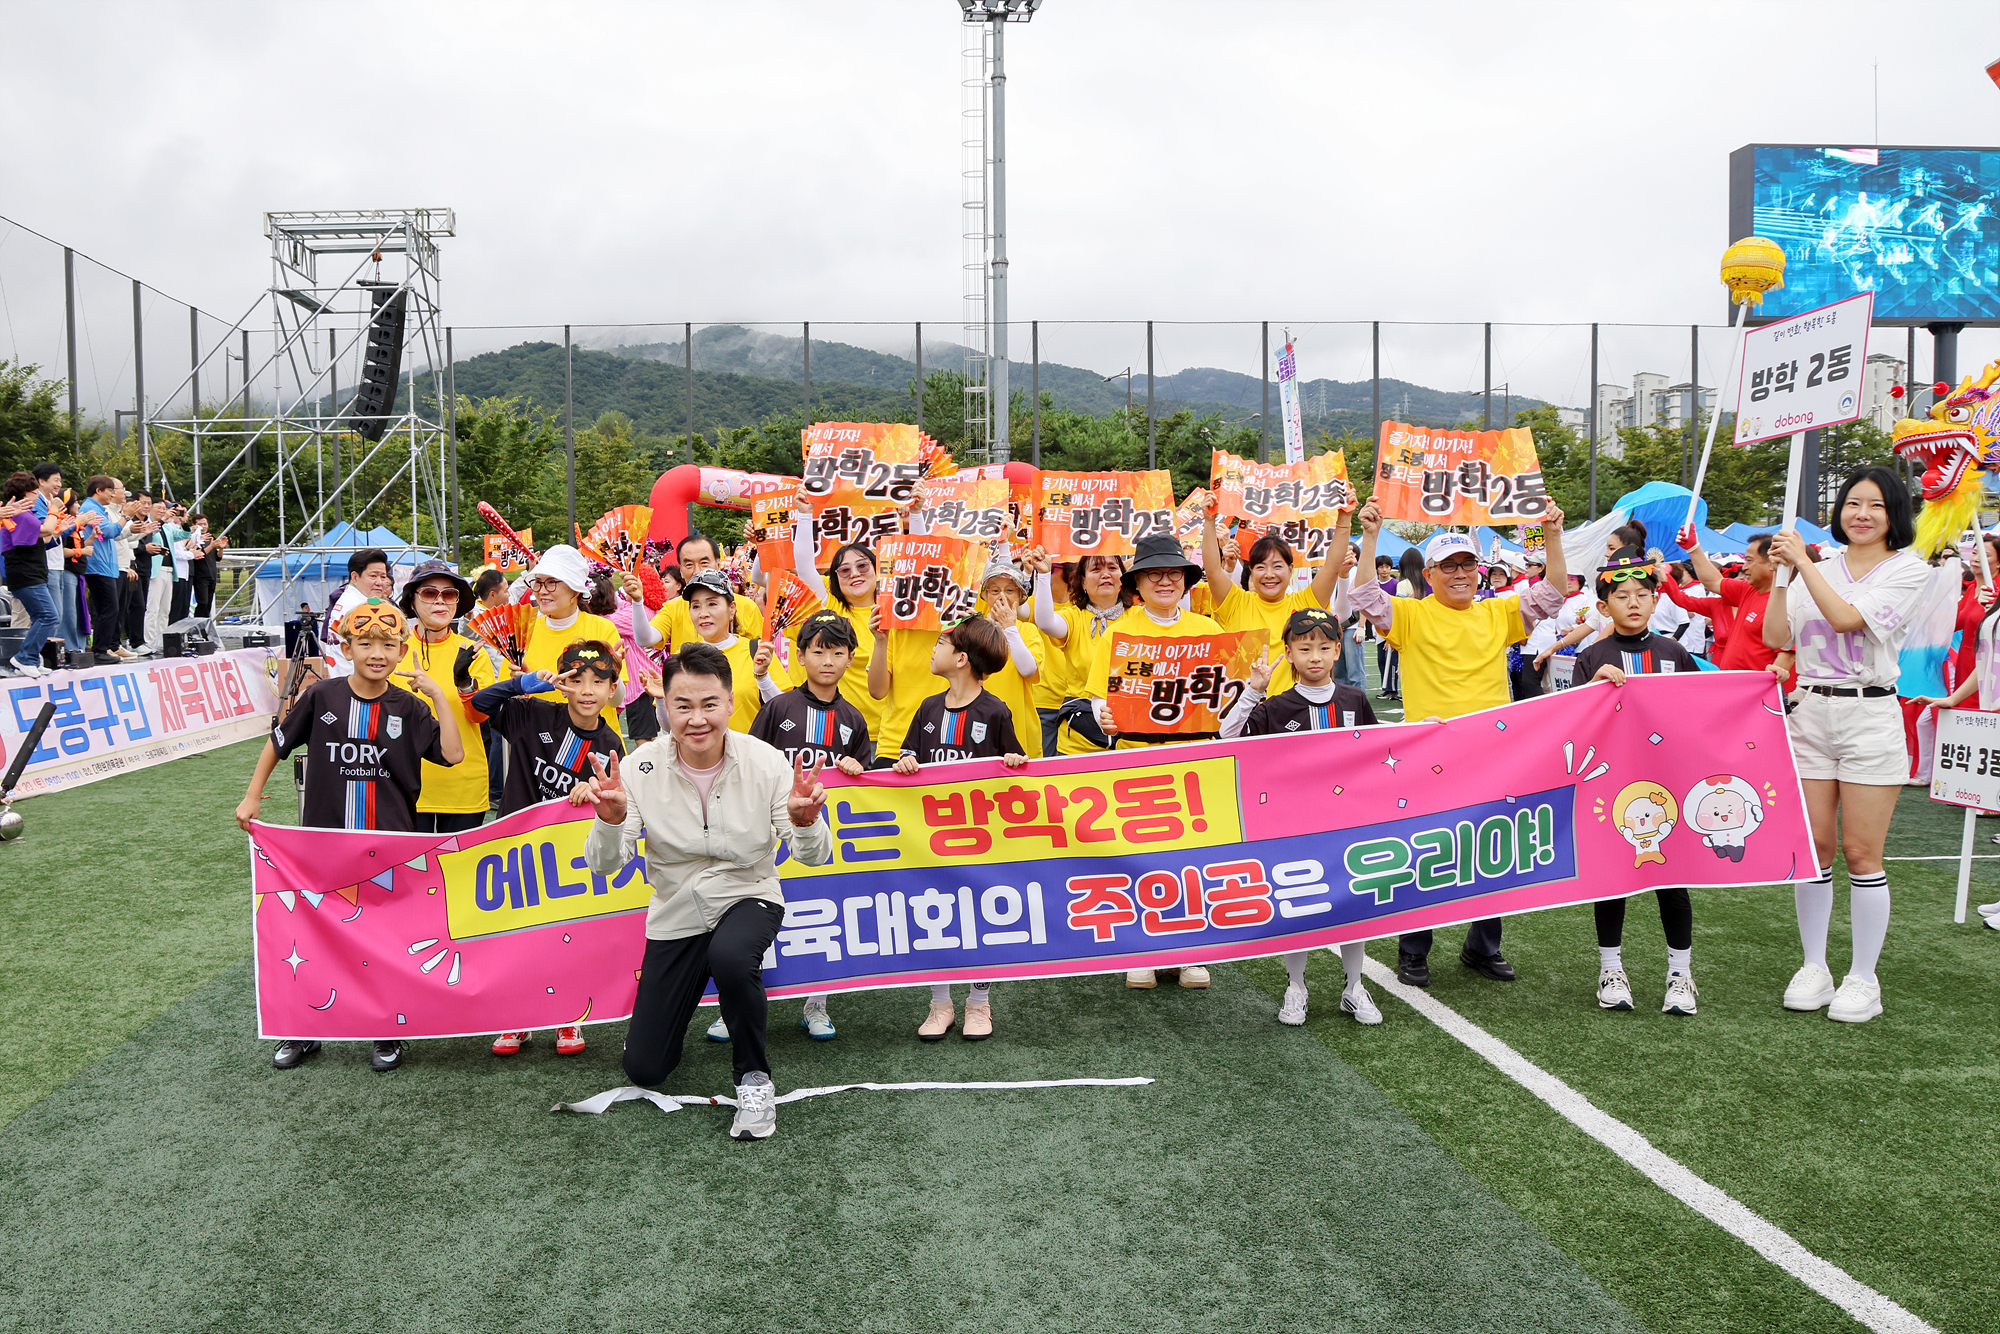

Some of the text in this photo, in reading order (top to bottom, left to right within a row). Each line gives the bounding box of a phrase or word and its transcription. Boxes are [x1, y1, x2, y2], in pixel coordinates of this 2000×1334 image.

[1803, 316, 1824, 332] 행복한
[1826, 311, 1837, 325] 도봉
[1751, 344, 1852, 402] 방학 2동
[1775, 411, 1813, 429] dobong
[823, 428, 860, 442] 이기자!
[1388, 430, 1473, 454] 즐기자! 이기자!
[1397, 448, 1447, 469] 도봉에서
[1254, 467, 1289, 478] 이기자!
[1042, 477, 1118, 492] 즐기자! 이기자!
[1379, 459, 1547, 518] 짱되는 방학2동
[754, 495, 793, 512] 즐기자!
[1048, 493, 1094, 506] 도봉에서
[1243, 478, 1347, 517] 방학2동
[755, 525, 791, 543] 짱되는
[905, 542, 942, 558] 이기자!
[1115, 641, 1211, 660] 즐기자! 이기자!
[1125, 661, 1181, 677] 도봉에서
[1107, 664, 1248, 726] 짱되는 방학2
[8, 673, 152, 765] 도봉구민
[147, 658, 255, 733] 체육대회
[325, 742, 388, 764] TORY
[1941, 743, 1972, 772] 방학
[340, 766, 376, 777] Football
[1955, 787, 1981, 804] dobong
[922, 771, 1208, 857] 방학2동!
[760, 803, 1555, 969] 육대회의 주인공은 우리야!
